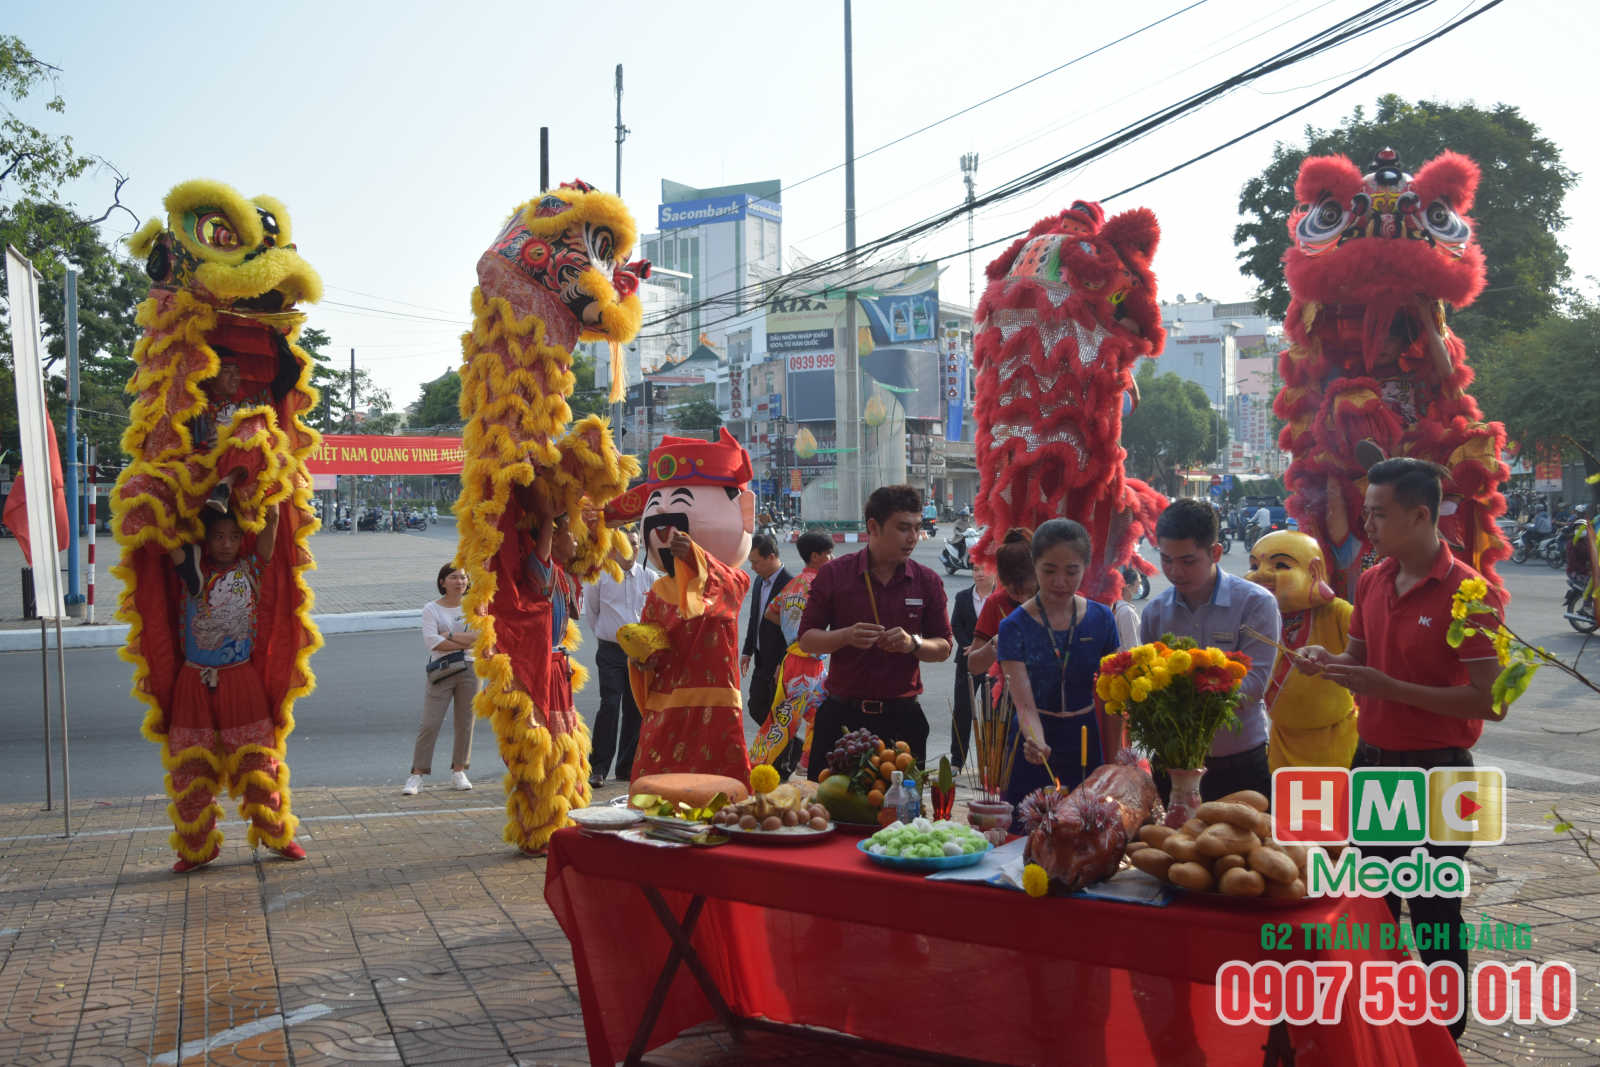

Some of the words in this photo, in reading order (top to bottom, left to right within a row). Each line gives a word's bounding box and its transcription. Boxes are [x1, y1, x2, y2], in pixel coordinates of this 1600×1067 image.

[661, 201, 740, 222] Sacombank
[747, 198, 781, 217] Sacombank
[790, 355, 815, 370] 0939
[312, 442, 338, 464] VIỆT
[341, 447, 368, 461] NAM
[371, 447, 409, 464] QUANG
[411, 448, 438, 462] VINH
[660, 459, 672, 475] 旺
[1418, 616, 1432, 627] NK
